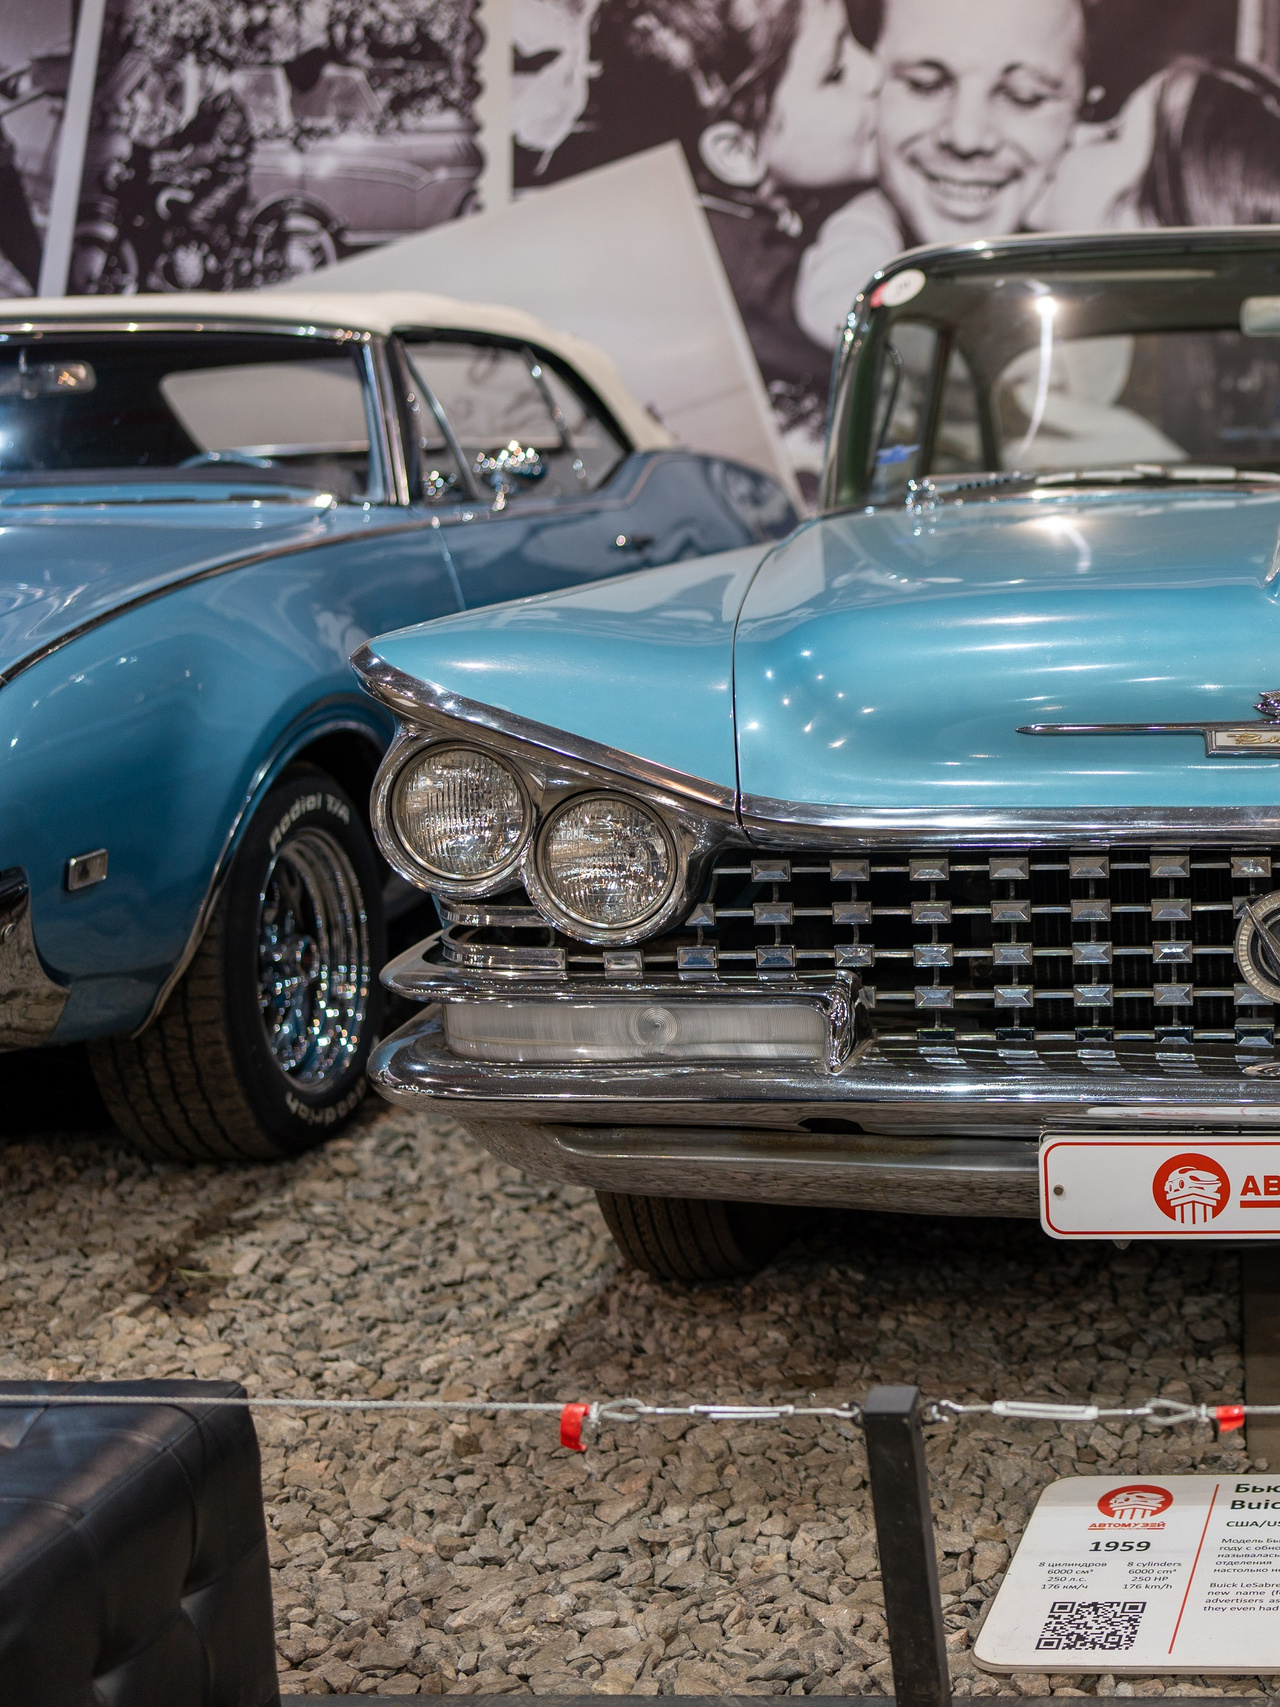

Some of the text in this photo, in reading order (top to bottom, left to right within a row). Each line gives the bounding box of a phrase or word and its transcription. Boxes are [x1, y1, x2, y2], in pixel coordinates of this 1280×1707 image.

[269, 792, 322, 854] Radial
[1089, 1520, 1166, 1528] АВТОМУЗЕЙ
[1088, 1540, 1151, 1552] 1959
[1062, 1583, 1089, 1591] км/ч
[1144, 1583, 1173, 1591] km/h
[1209, 1581, 1238, 1589] Buick
[1203, 1605, 1228, 1613] they
